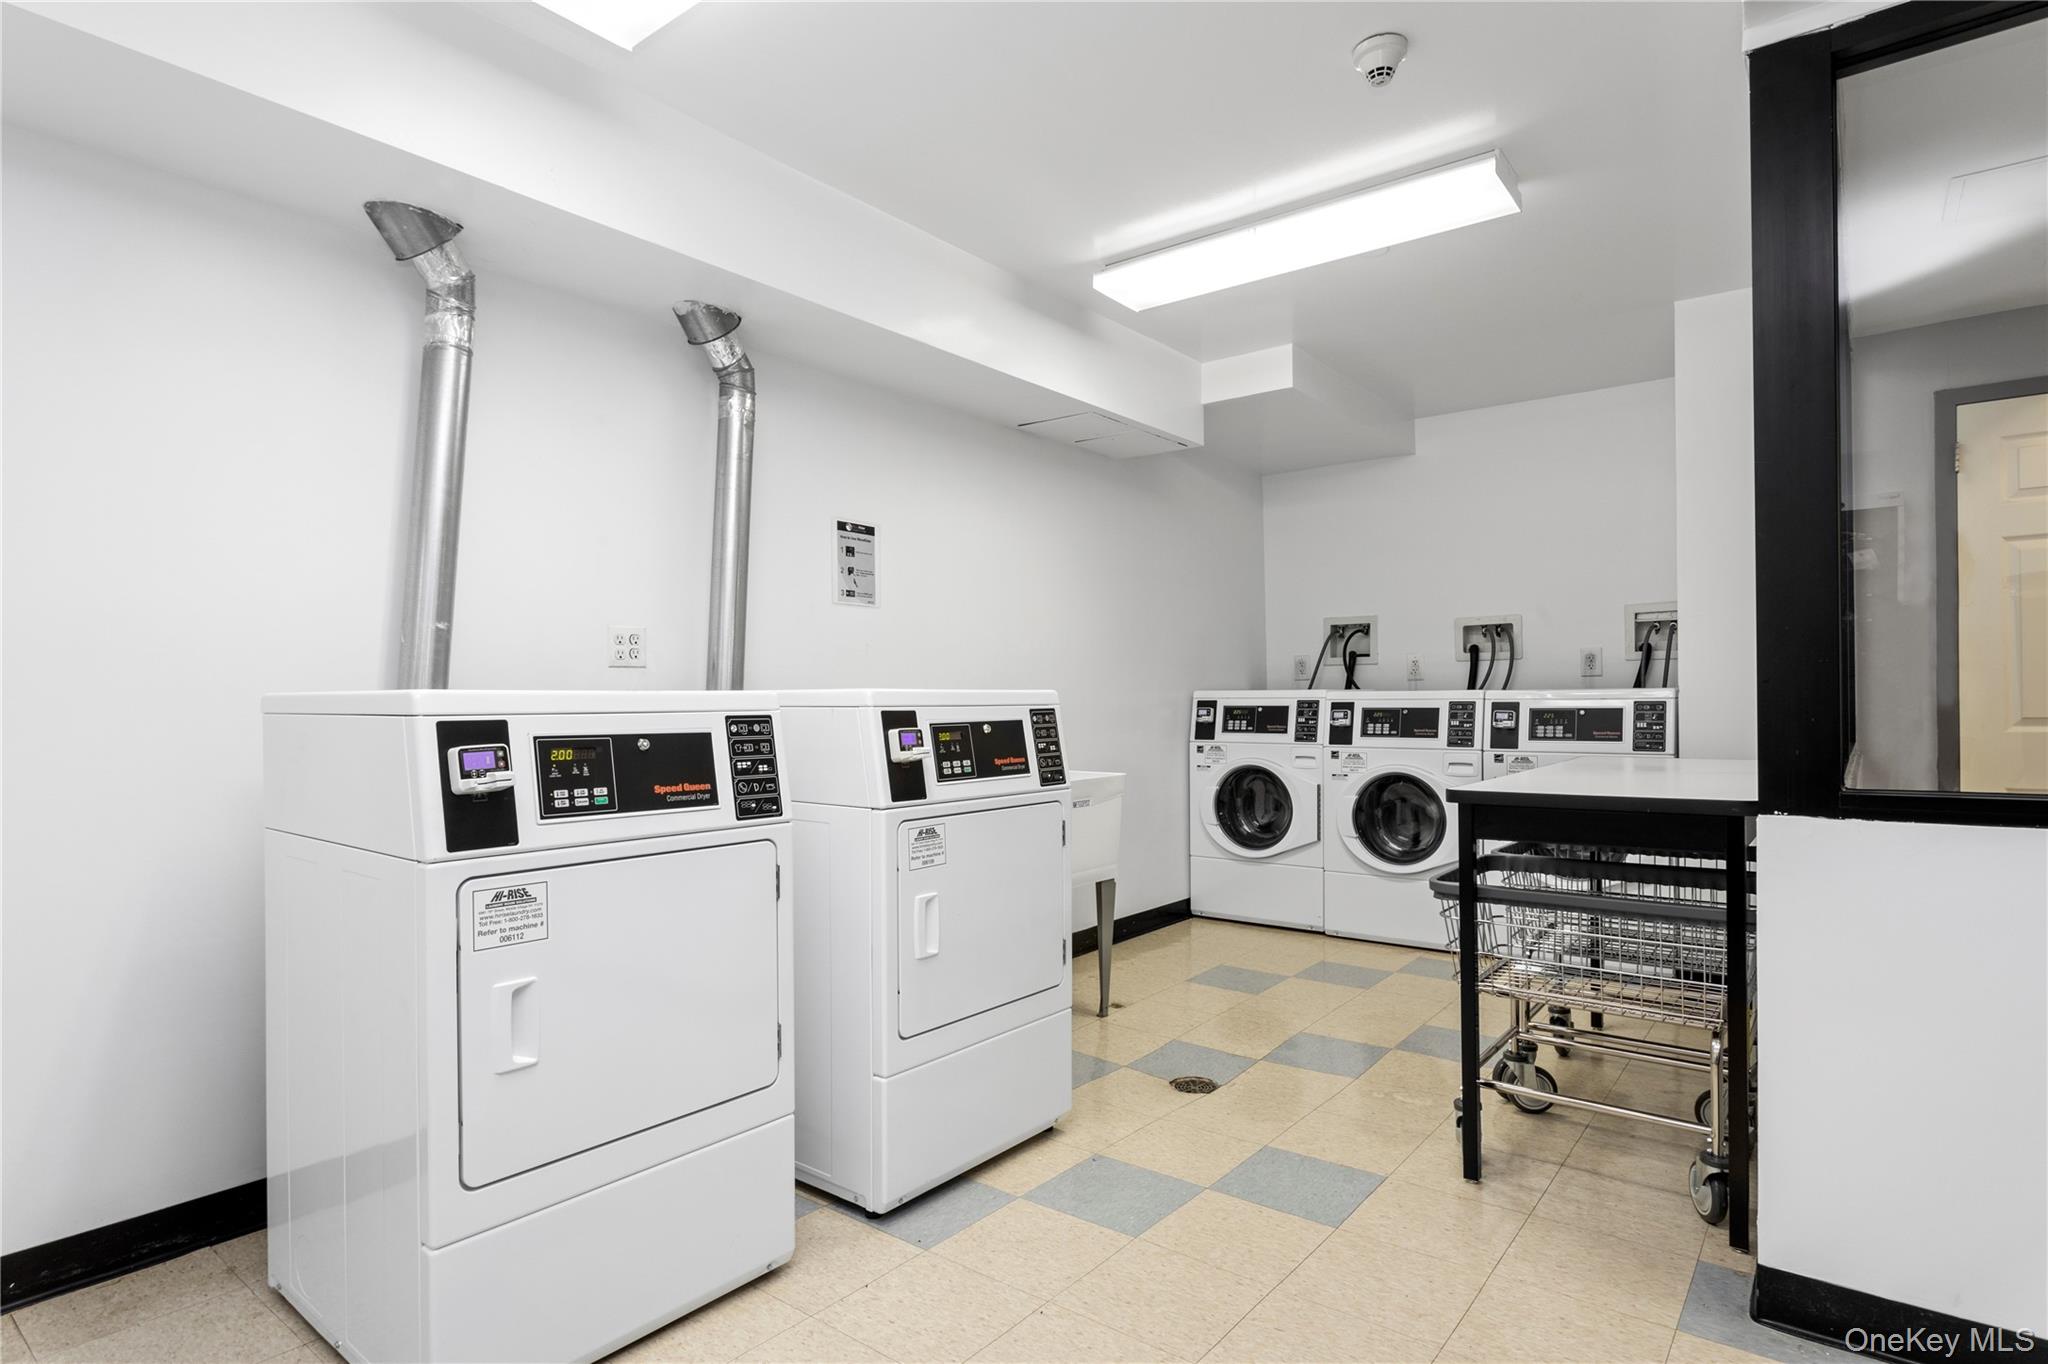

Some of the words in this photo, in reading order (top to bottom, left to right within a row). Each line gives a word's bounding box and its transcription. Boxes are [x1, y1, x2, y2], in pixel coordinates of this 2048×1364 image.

[654, 783, 682, 795] Speed
[683, 782, 711, 791] Queen
[666, 793, 696, 802] Commercial
[696, 792, 711, 800] Dryer
[490, 888, 532, 903] HI-RISE
[478, 928, 498, 937] Refer
[508, 922, 538, 933] machine
[499, 932, 524, 943] 006112
